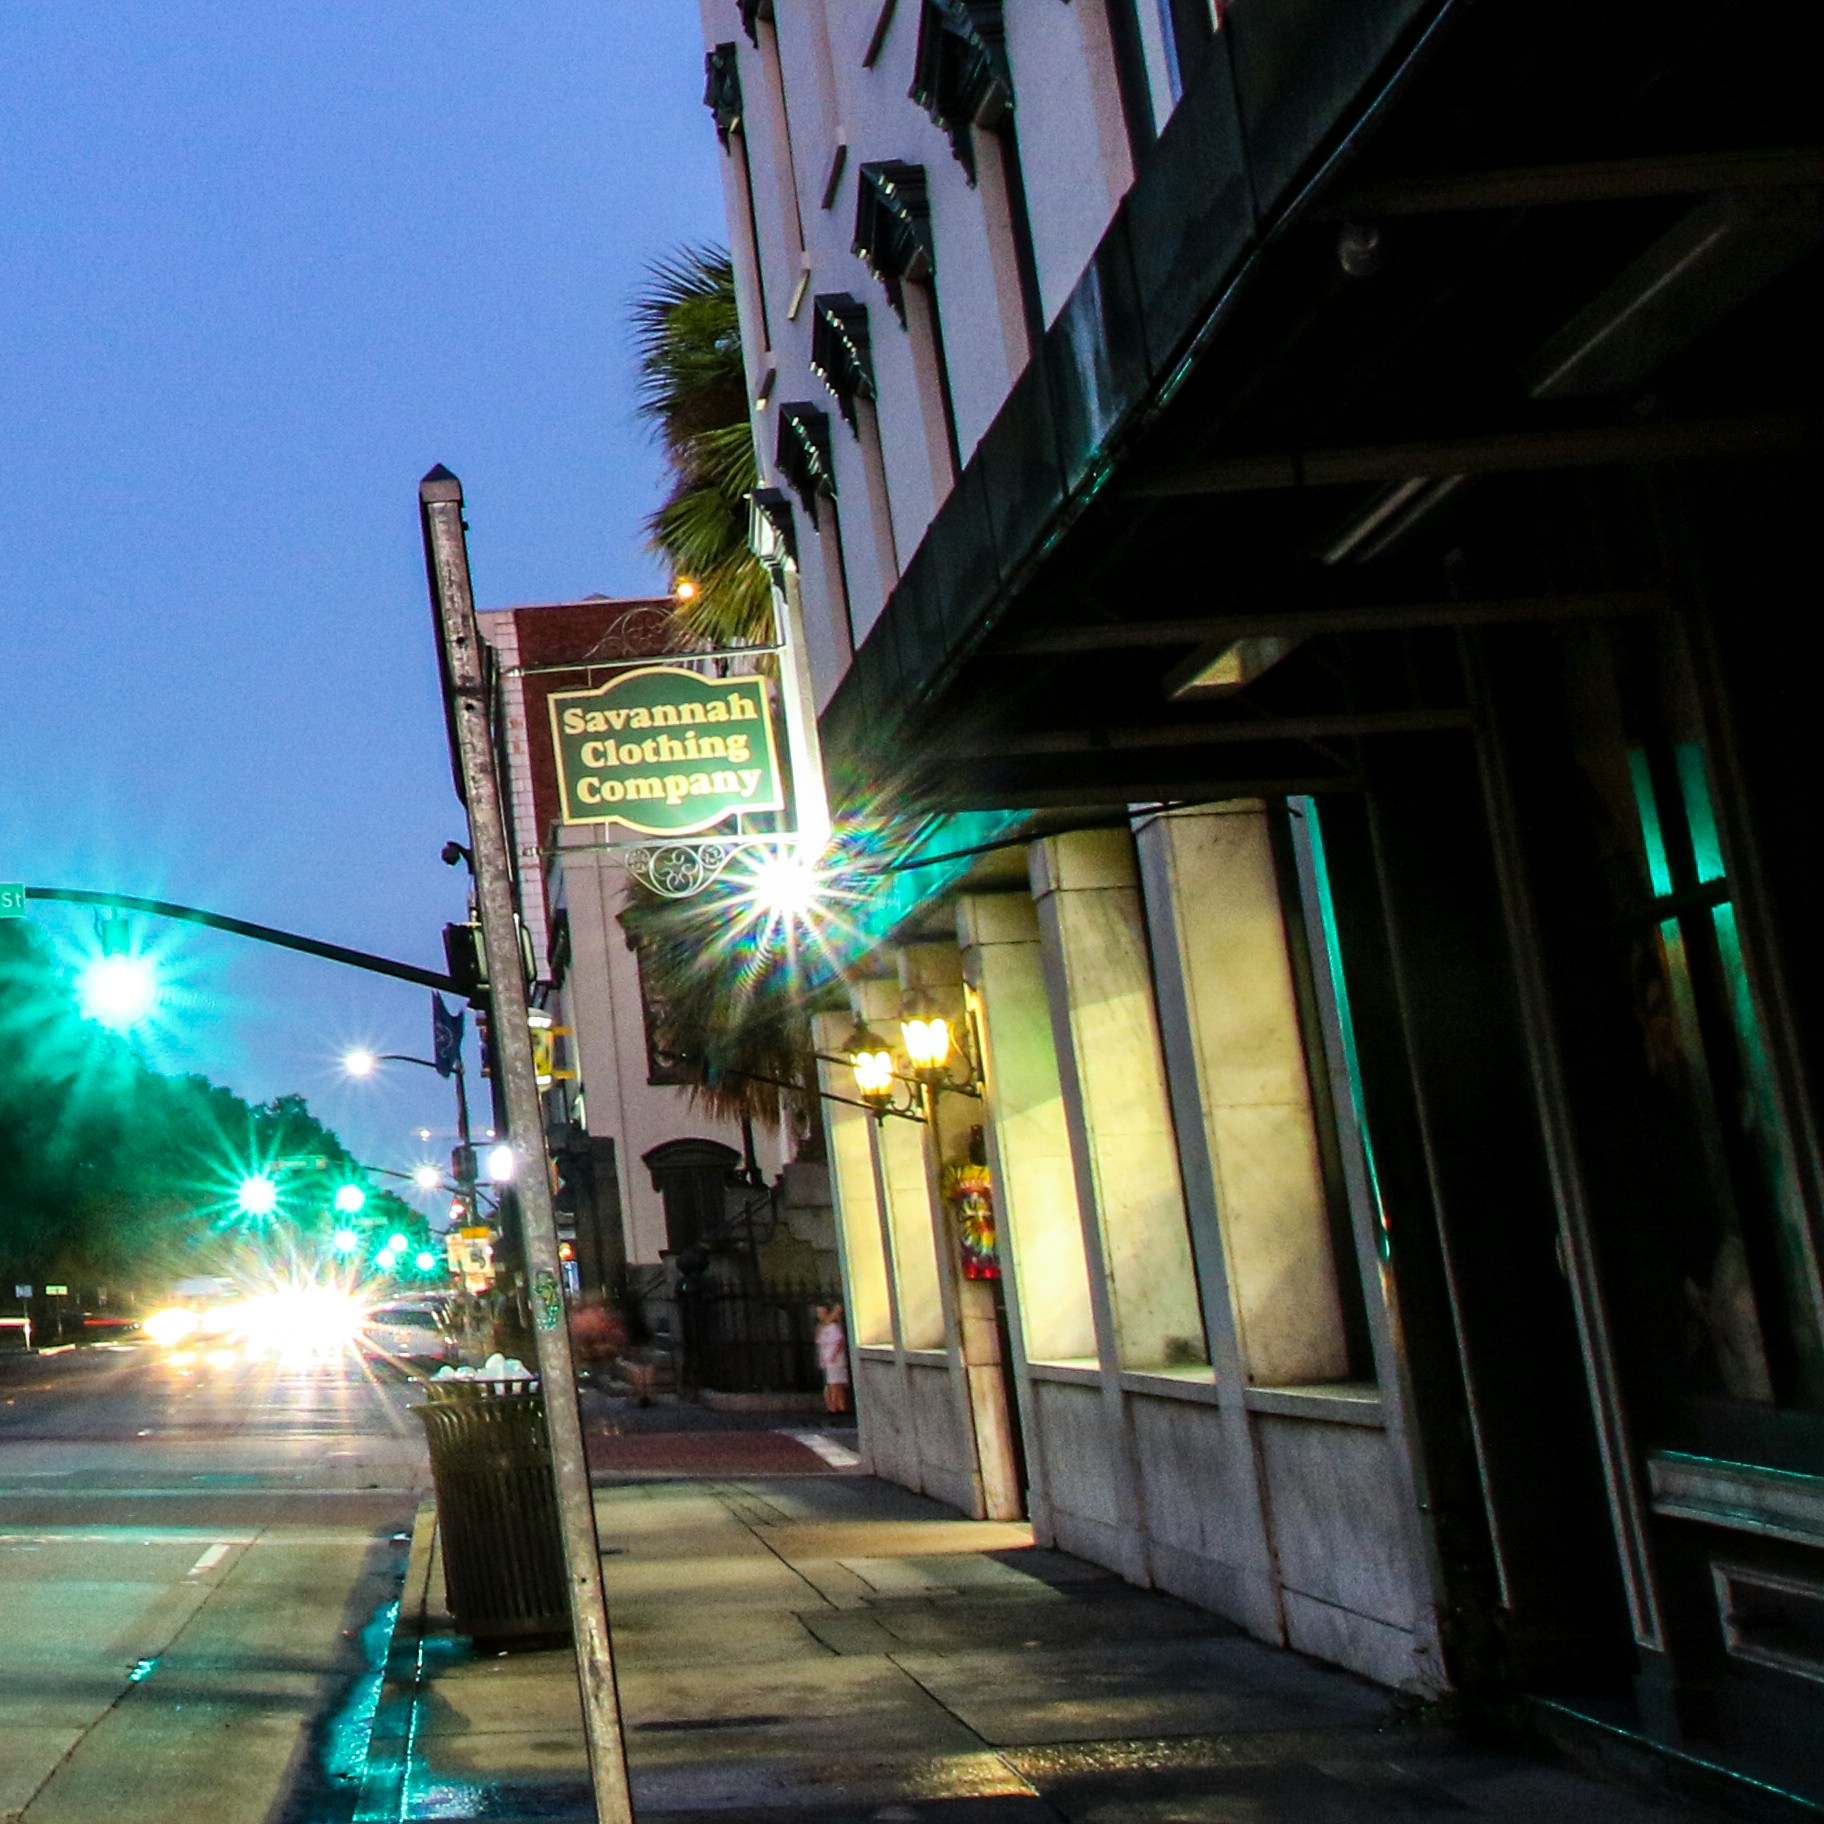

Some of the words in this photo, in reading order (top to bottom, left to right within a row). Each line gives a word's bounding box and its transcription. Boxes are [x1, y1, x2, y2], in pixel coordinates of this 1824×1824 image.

[563, 693, 758, 735] Savannah
[580, 731, 752, 769] Clothing
[576, 767, 762, 805] Company
[1, 892, 22, 908] St
